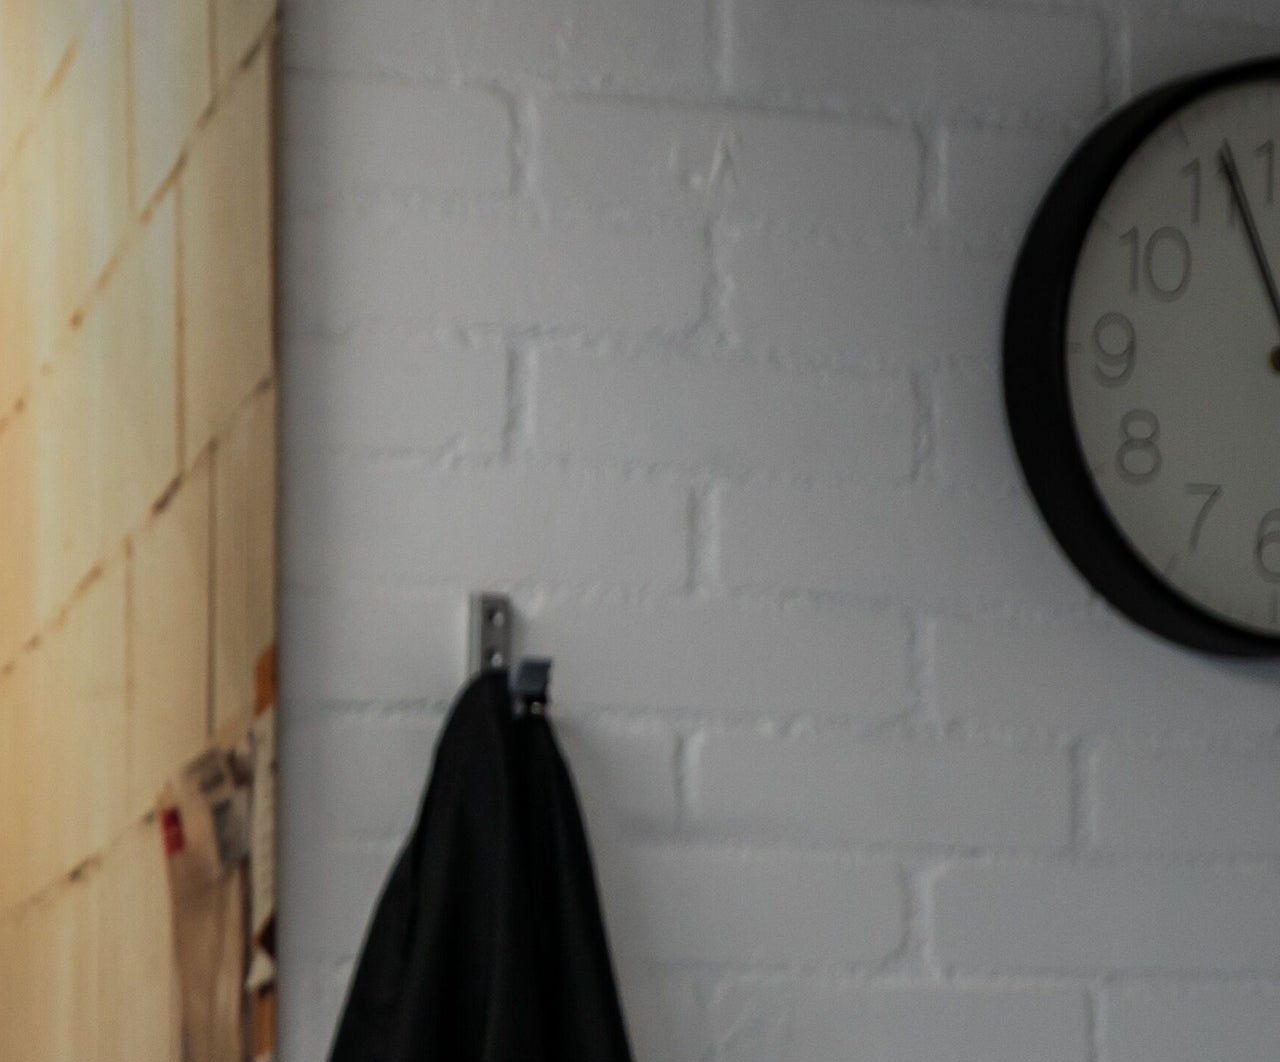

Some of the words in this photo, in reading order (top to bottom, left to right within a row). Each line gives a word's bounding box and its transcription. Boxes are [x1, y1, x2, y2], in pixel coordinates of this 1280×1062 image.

[1119, 224, 1192, 301] 10
[1092, 311, 1138, 389] 9
[1115, 408, 1162, 486] 8
[1185, 482, 1223, 552] 7
